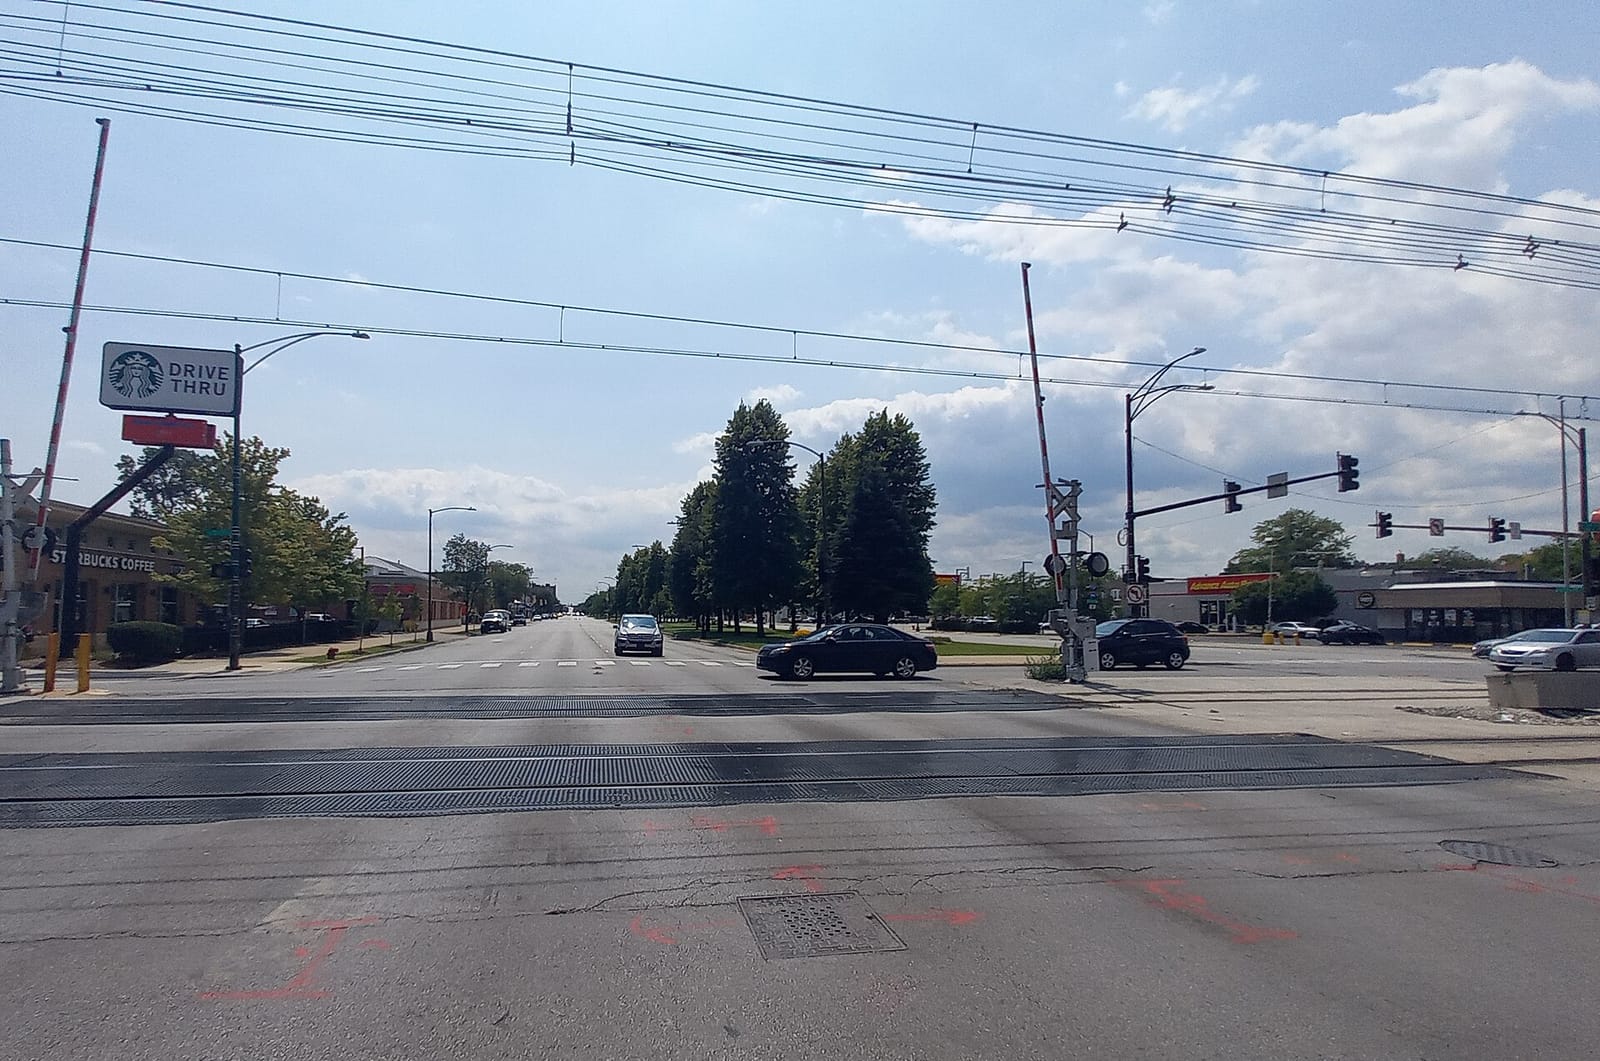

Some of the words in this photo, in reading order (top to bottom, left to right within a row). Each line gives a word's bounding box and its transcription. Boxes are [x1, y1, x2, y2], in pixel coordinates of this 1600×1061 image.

[170, 362, 229, 380] DRIVE
[171, 379, 226, 396] THRU
[51, 549, 119, 569] STRBUCKS
[121, 557, 156, 572] COFFEE
